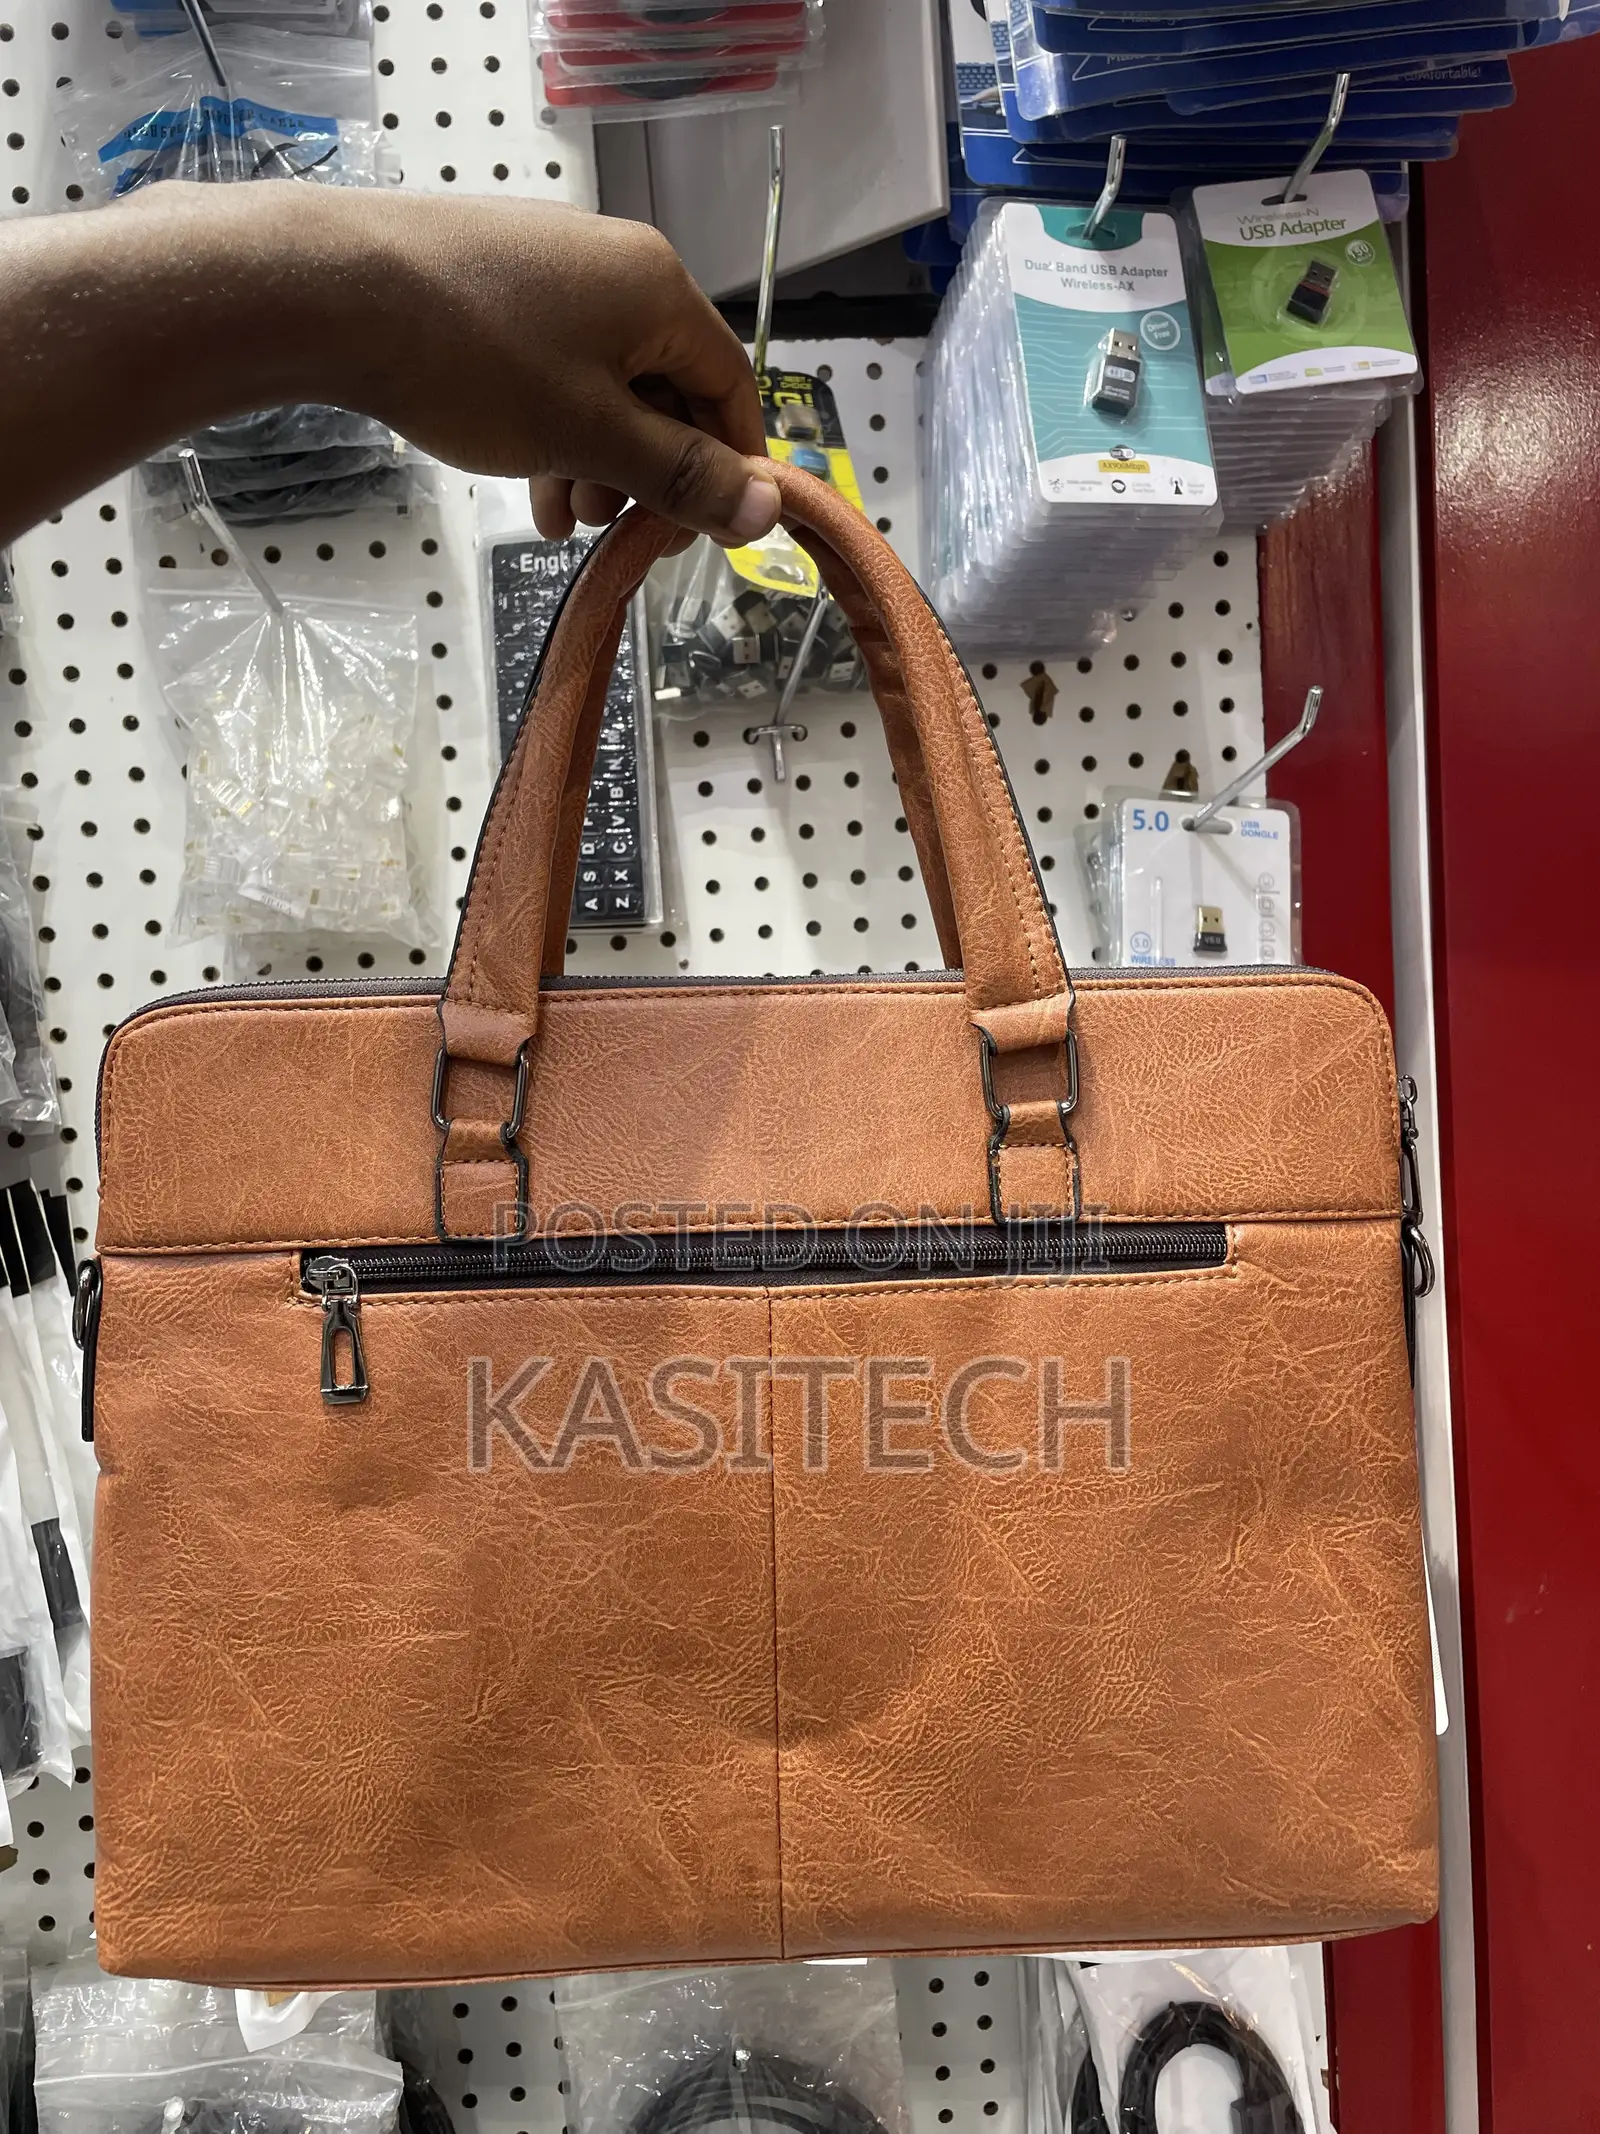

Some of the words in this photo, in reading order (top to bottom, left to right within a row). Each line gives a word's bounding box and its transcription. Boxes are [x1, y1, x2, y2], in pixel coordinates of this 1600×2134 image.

[1239, 223, 1277, 242] USB
[1280, 217, 1347, 237] Adapter
[1056, 261, 1088, 275] Band
[1091, 264, 1118, 276] USB
[1120, 265, 1169, 280] Adapter
[1060, 277, 1136, 292] Wireless-AX
[1132, 809, 1170, 832] 5.0
[1240, 829, 1279, 840] DONGLE
[582, 870, 597, 882] S
[614, 868, 629, 882] X
[584, 897, 599, 911] A
